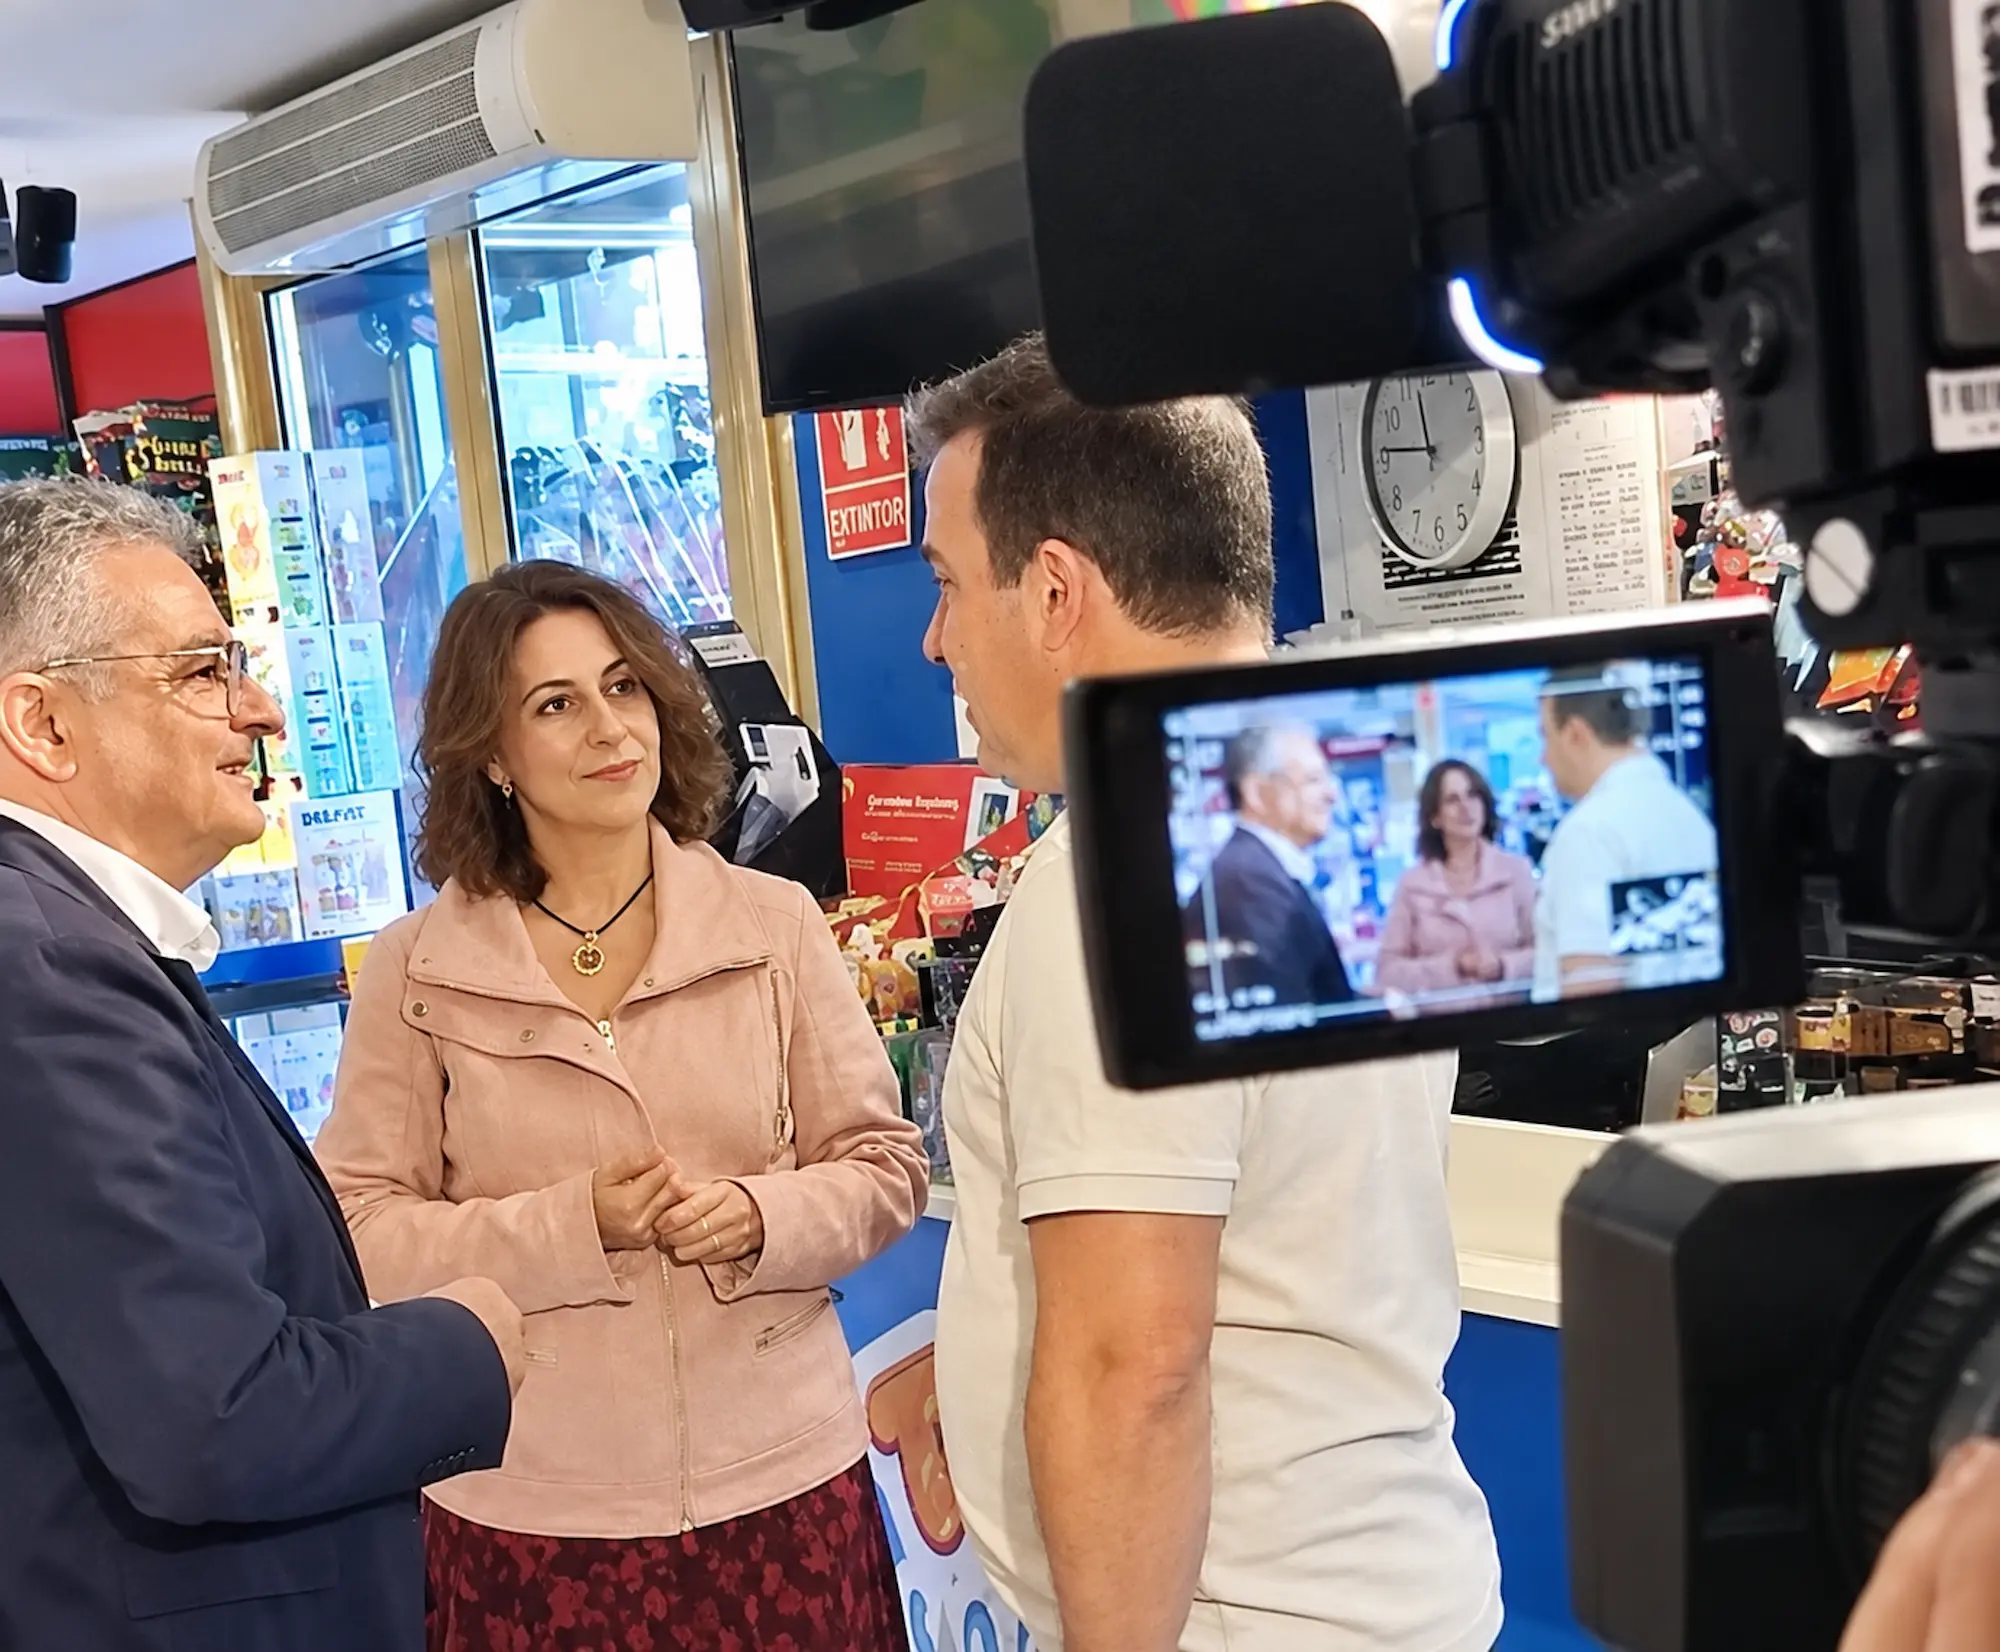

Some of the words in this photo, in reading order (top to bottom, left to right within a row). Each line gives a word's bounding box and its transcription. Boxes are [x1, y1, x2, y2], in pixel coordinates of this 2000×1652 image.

[1465, 386, 1475, 412] 2
[1384, 405, 1400, 433] 10
[1473, 425, 1484, 455] 3
[1380, 446, 1390, 474] 9
[1471, 468, 1481, 497] 4
[1392, 484, 1402, 512] 8
[829, 496, 905, 539] EXTINTOR
[1412, 509, 1421, 534] 7
[1434, 516, 1445, 543] 6
[1456, 503, 1468, 532] 5
